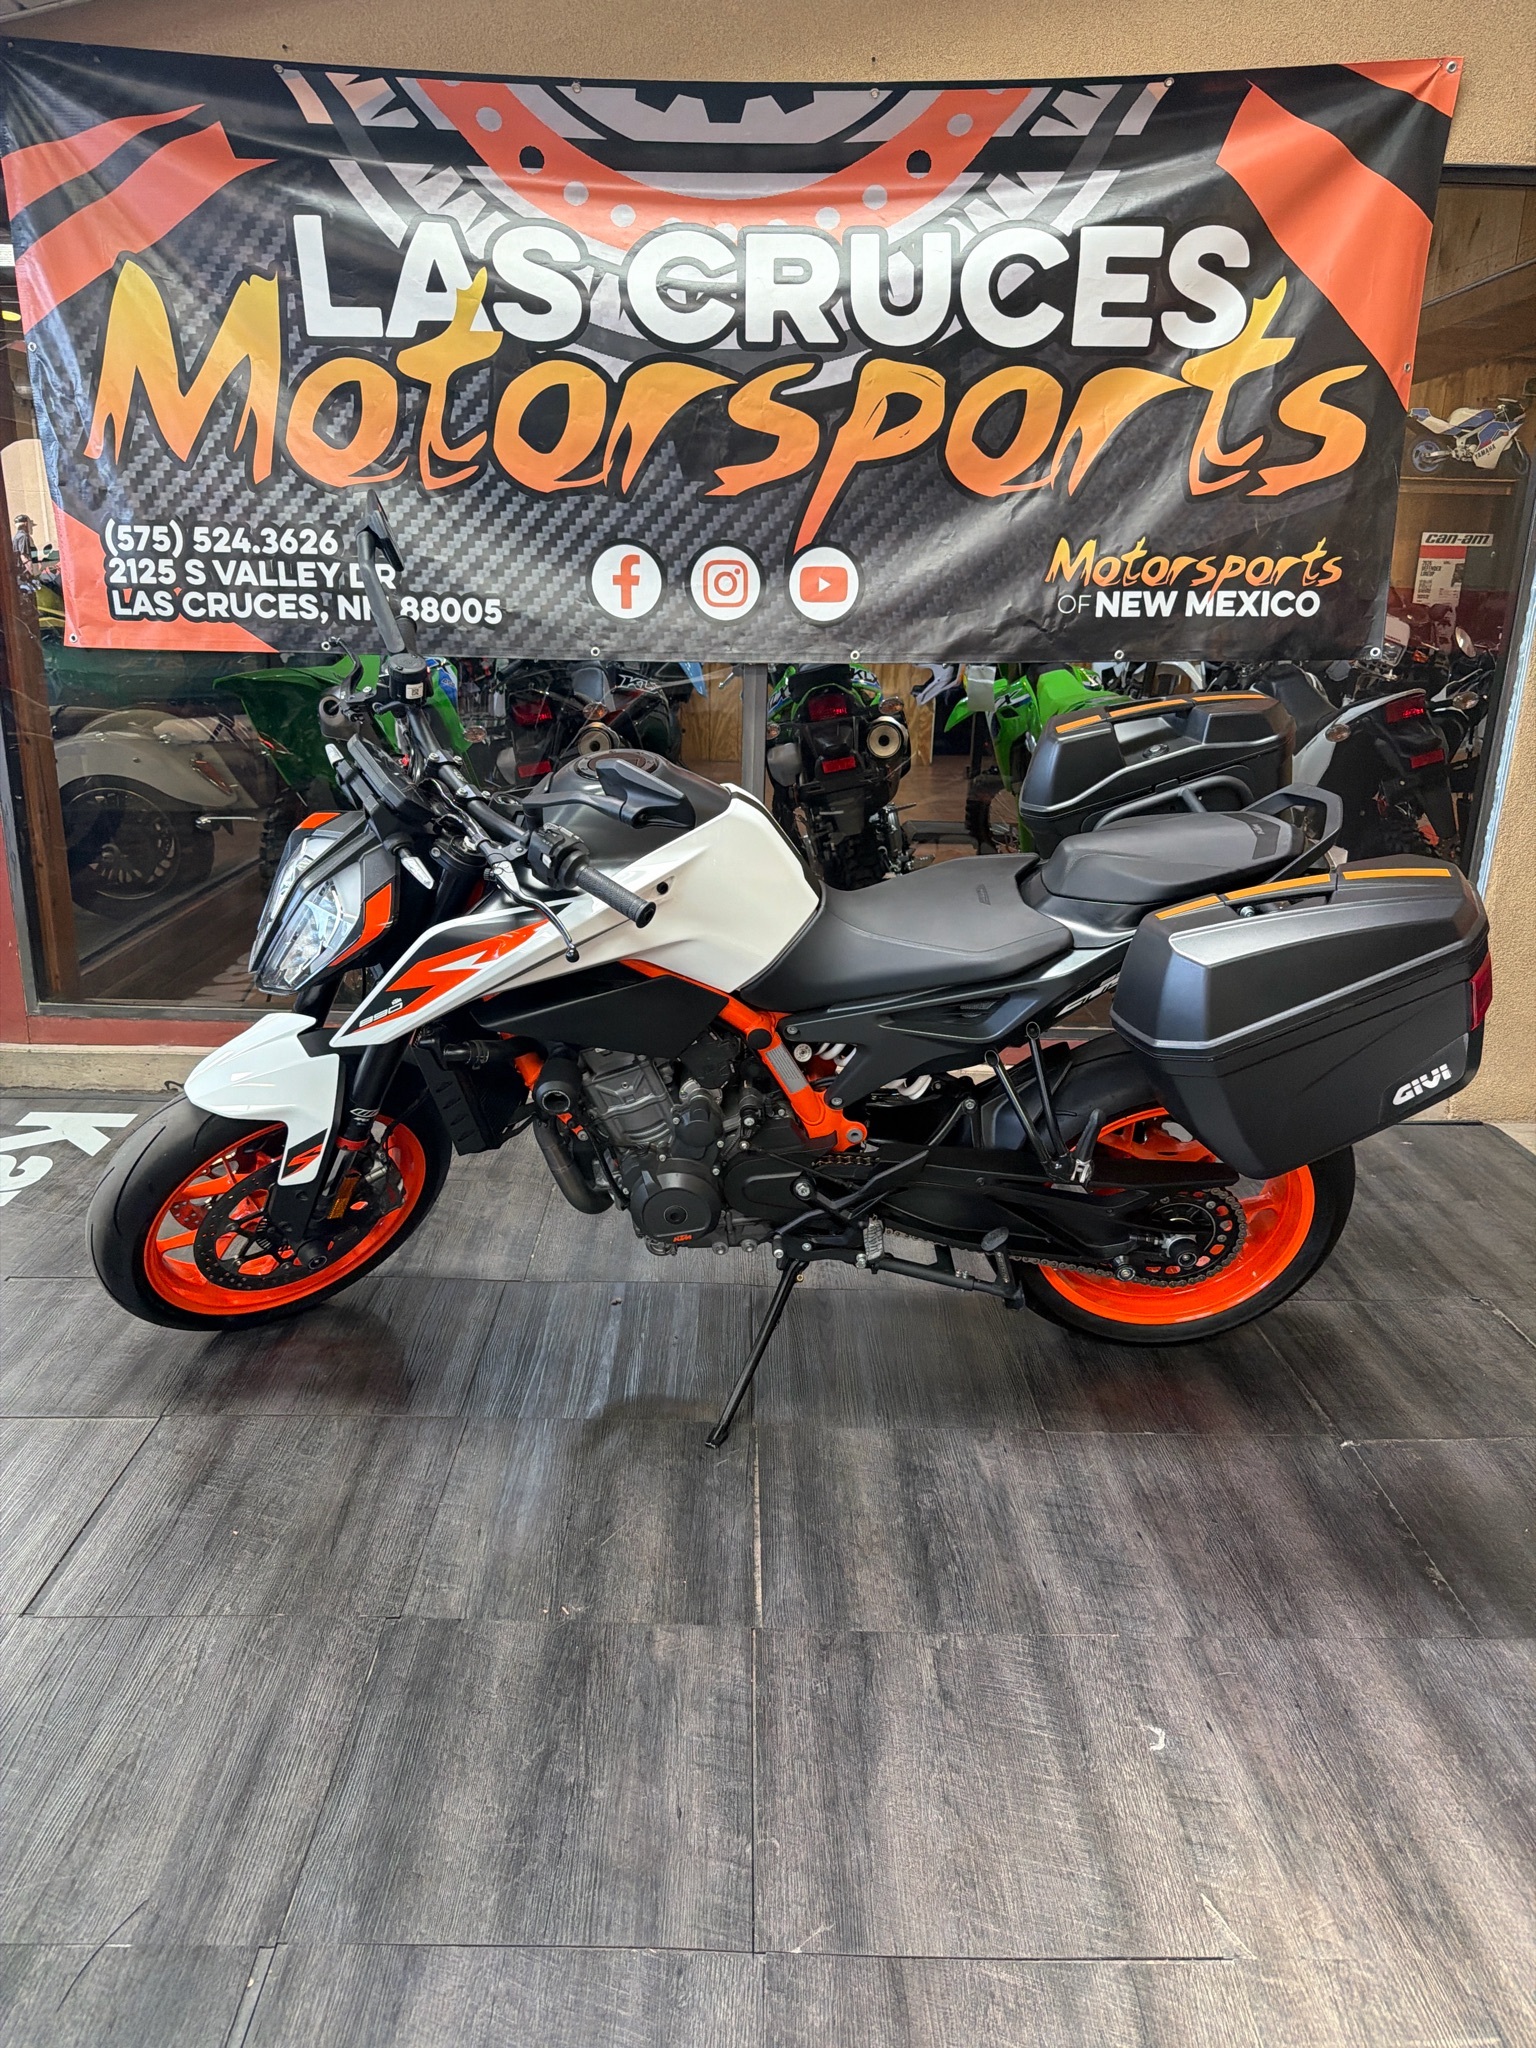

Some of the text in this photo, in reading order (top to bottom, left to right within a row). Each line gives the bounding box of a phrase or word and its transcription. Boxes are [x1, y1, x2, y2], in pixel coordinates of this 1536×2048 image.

[293, 214, 1252, 348] LAS CRUCES
[84, 259, 1369, 553] Motorsports
[1474, 443, 1497, 461] YAMAHA
[105, 518, 339, 557] (575) 524.3626
[1425, 533, 1490, 545] can-am
[109, 558, 176, 585] 2125
[186, 560, 206, 585] S
[211, 560, 341, 588] VALLEY
[1044, 536, 1344, 598] Motorsports
[112, 588, 174, 616] LAS
[181, 591, 328, 624] CRUCES,
[400, 596, 502, 624] 88005
[1057, 590, 1321, 617] OF NEW MEXICO
[1392, 1063, 1452, 1106] GIVI
[672, 1234, 693, 1243] KTM
